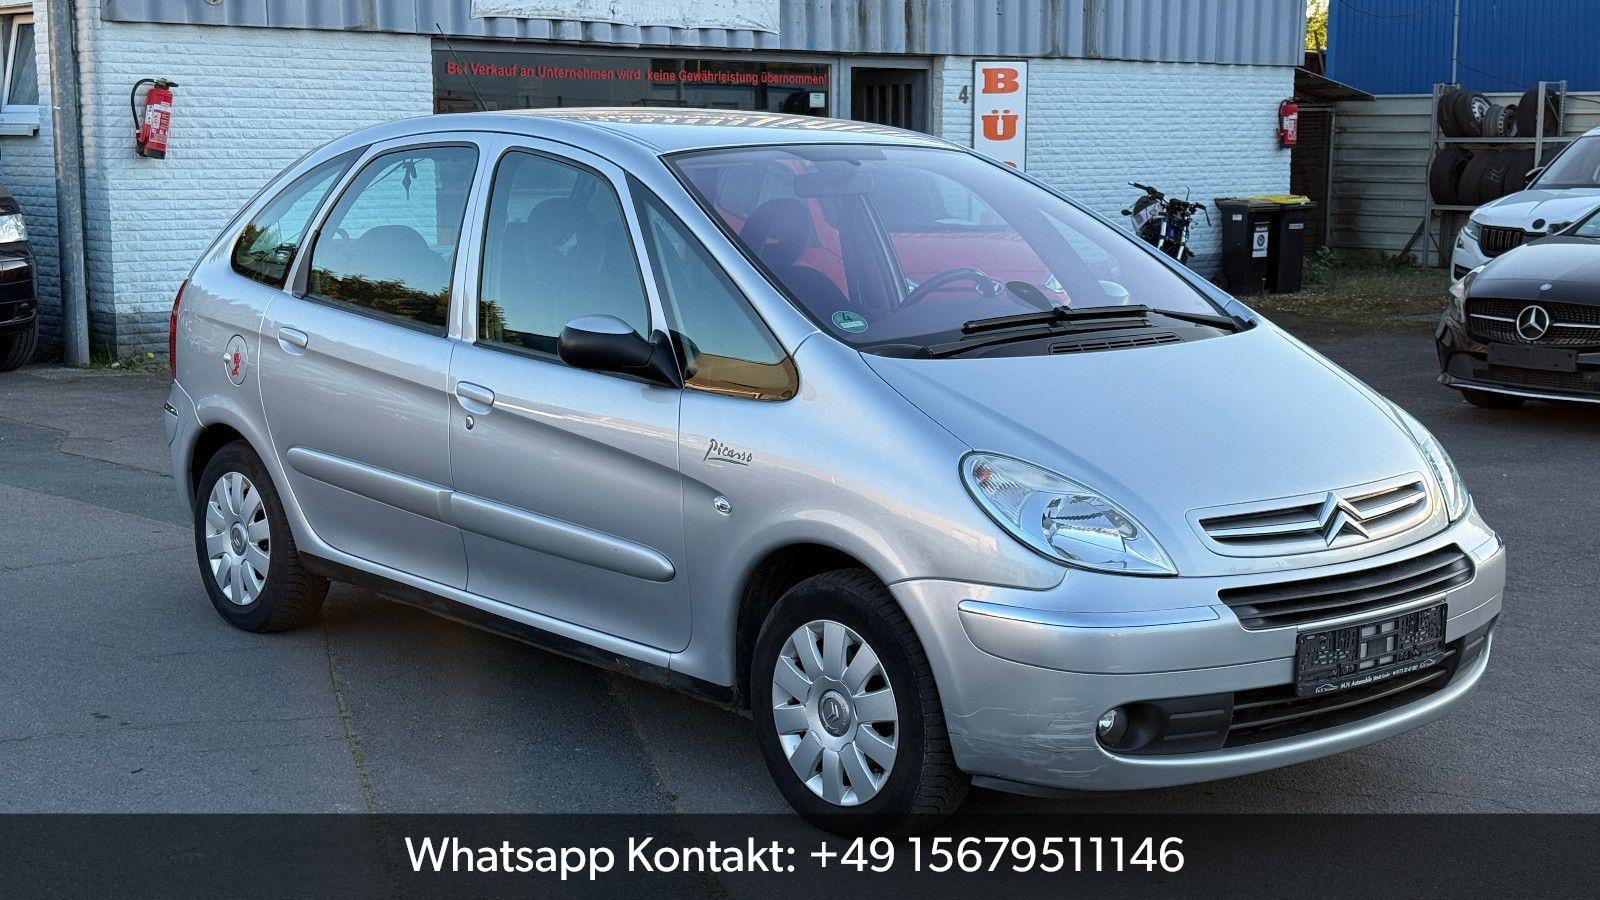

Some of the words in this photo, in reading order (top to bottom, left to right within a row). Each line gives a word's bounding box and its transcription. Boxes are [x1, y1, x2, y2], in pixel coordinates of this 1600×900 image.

[446, 61, 467, 76] Bei
[470, 62, 517, 77] Verkauf
[520, 68, 534, 77] an
[537, 67, 614, 80] Unternehmen
[617, 67, 641, 81] wird
[647, 71, 676, 82] keine
[678, 71, 759, 86] Gewährleistung
[761, 72, 827, 85] übernommen!
[958, 85, 969, 104] 4
[703, 438, 753, 463] Picasso
